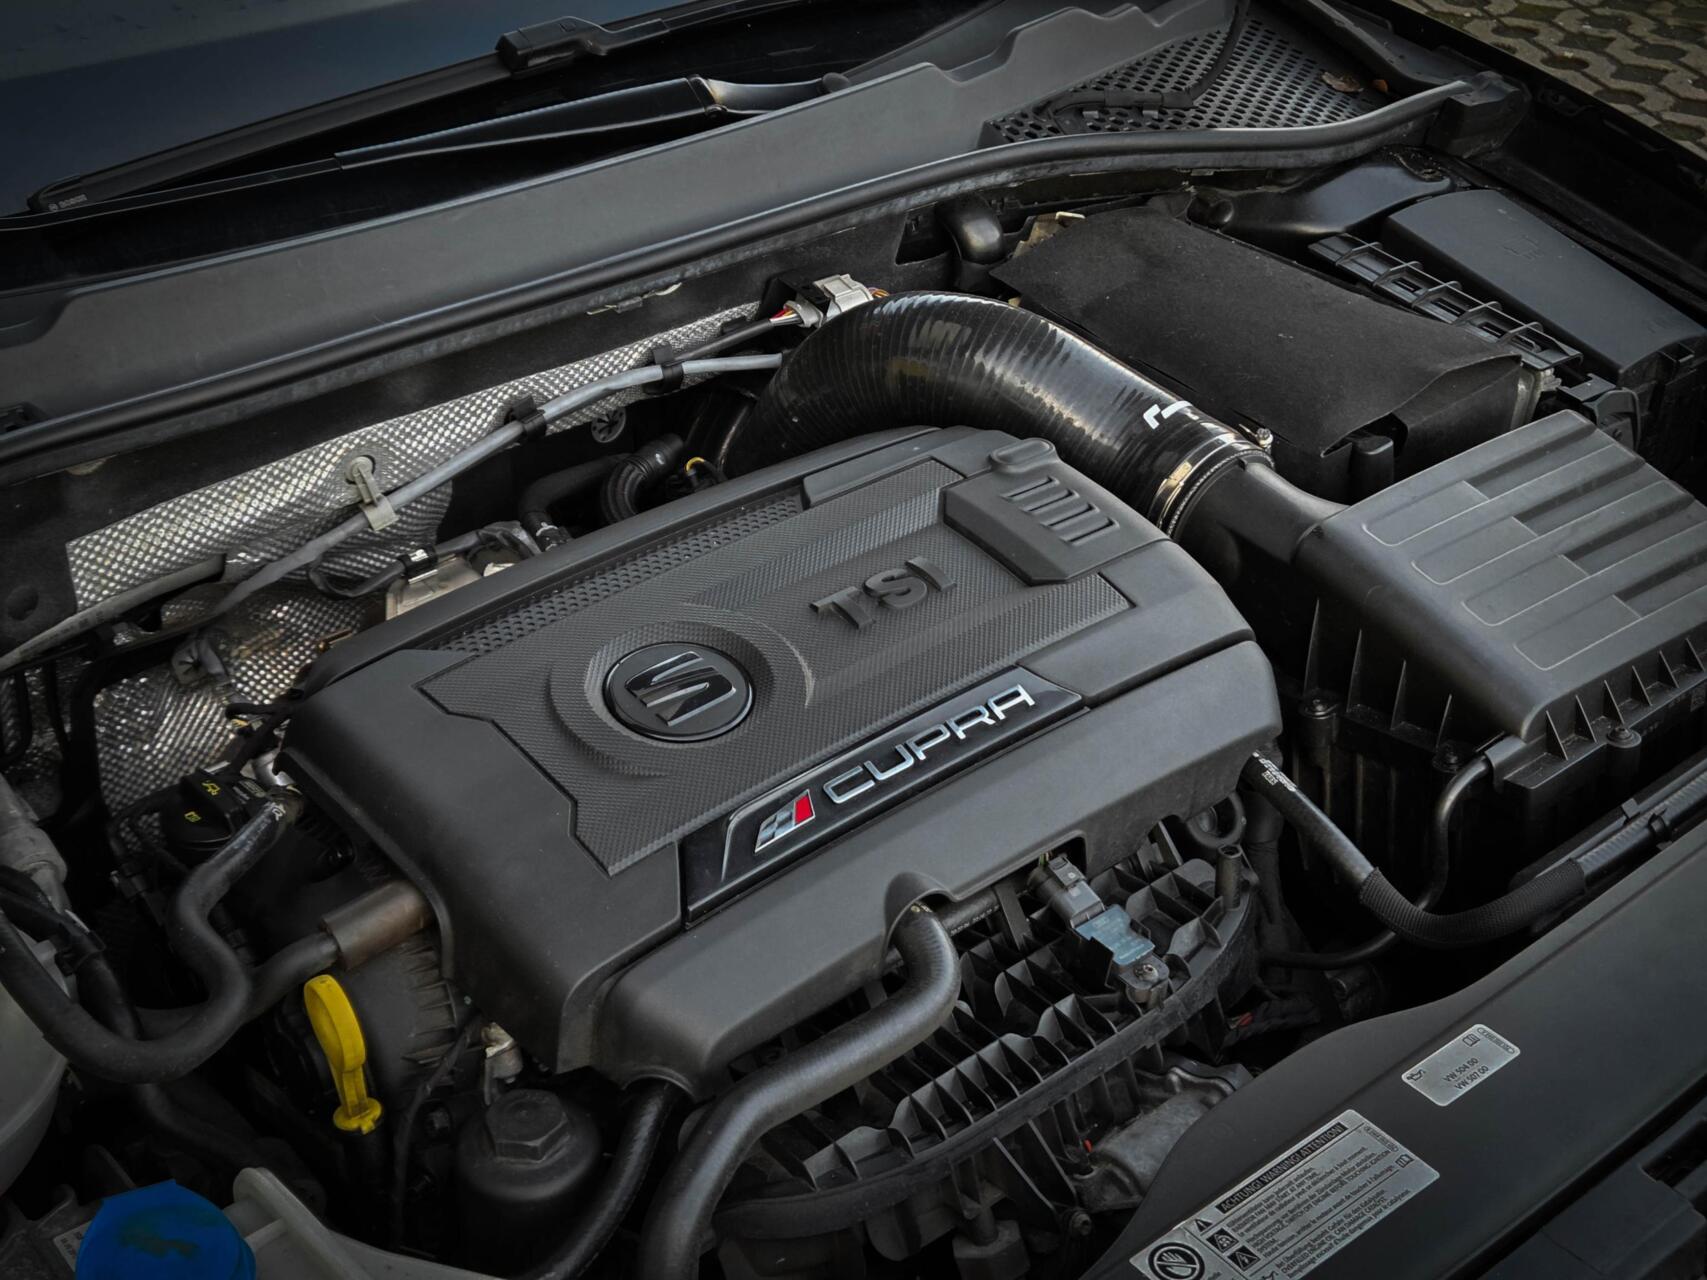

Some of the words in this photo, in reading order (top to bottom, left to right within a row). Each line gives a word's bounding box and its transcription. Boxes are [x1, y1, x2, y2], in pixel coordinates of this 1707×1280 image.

[810, 555, 957, 631] TSI
[822, 684, 1037, 805] CUPRA
[1443, 1072, 1457, 1081] VW
[1467, 1058, 1478, 1066] 00
[1455, 1080, 1469, 1090] VW
[1478, 1066, 1489, 1074] 00
[1220, 1180, 1262, 1210] ACHTUNG!
[1260, 1153, 1301, 1183] WARNING!
[1299, 1125, 1344, 1156] ATTENTION!
